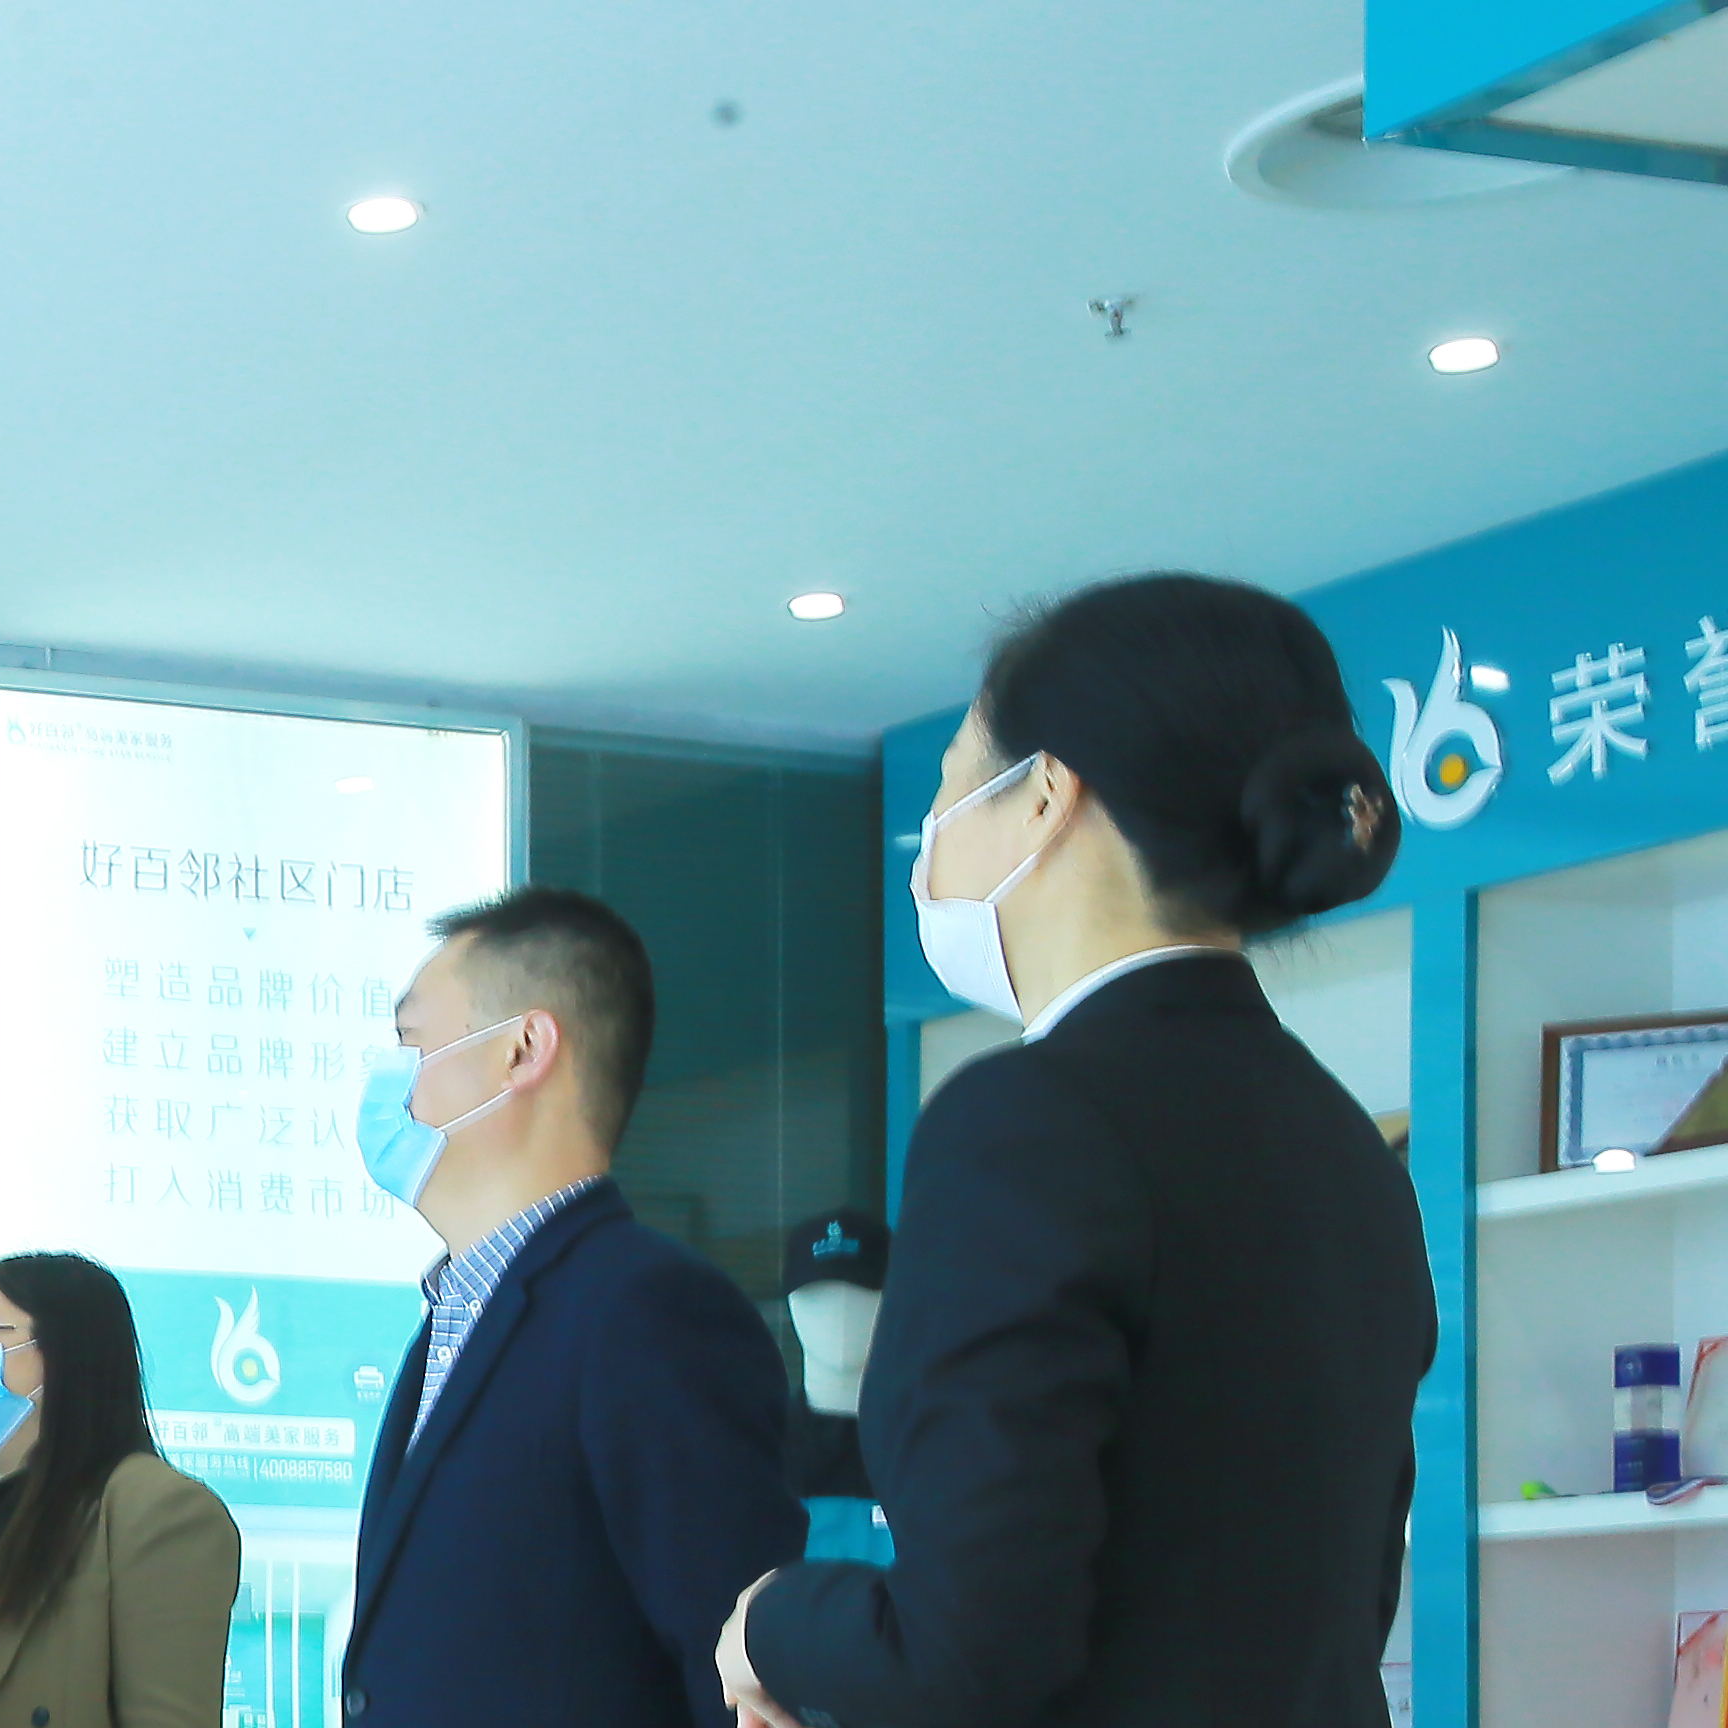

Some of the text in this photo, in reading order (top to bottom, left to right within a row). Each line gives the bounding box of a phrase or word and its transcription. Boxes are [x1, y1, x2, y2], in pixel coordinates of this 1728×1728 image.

[79, 838, 414, 914] 好百邻社区门店
[103, 957, 395, 1020] 塑造品牌价值
[103, 1162, 397, 1222] 打入消费市场
[223, 1423, 341, 1448] 高端美家服务
[259, 1458, 354, 1481] 4008857580
